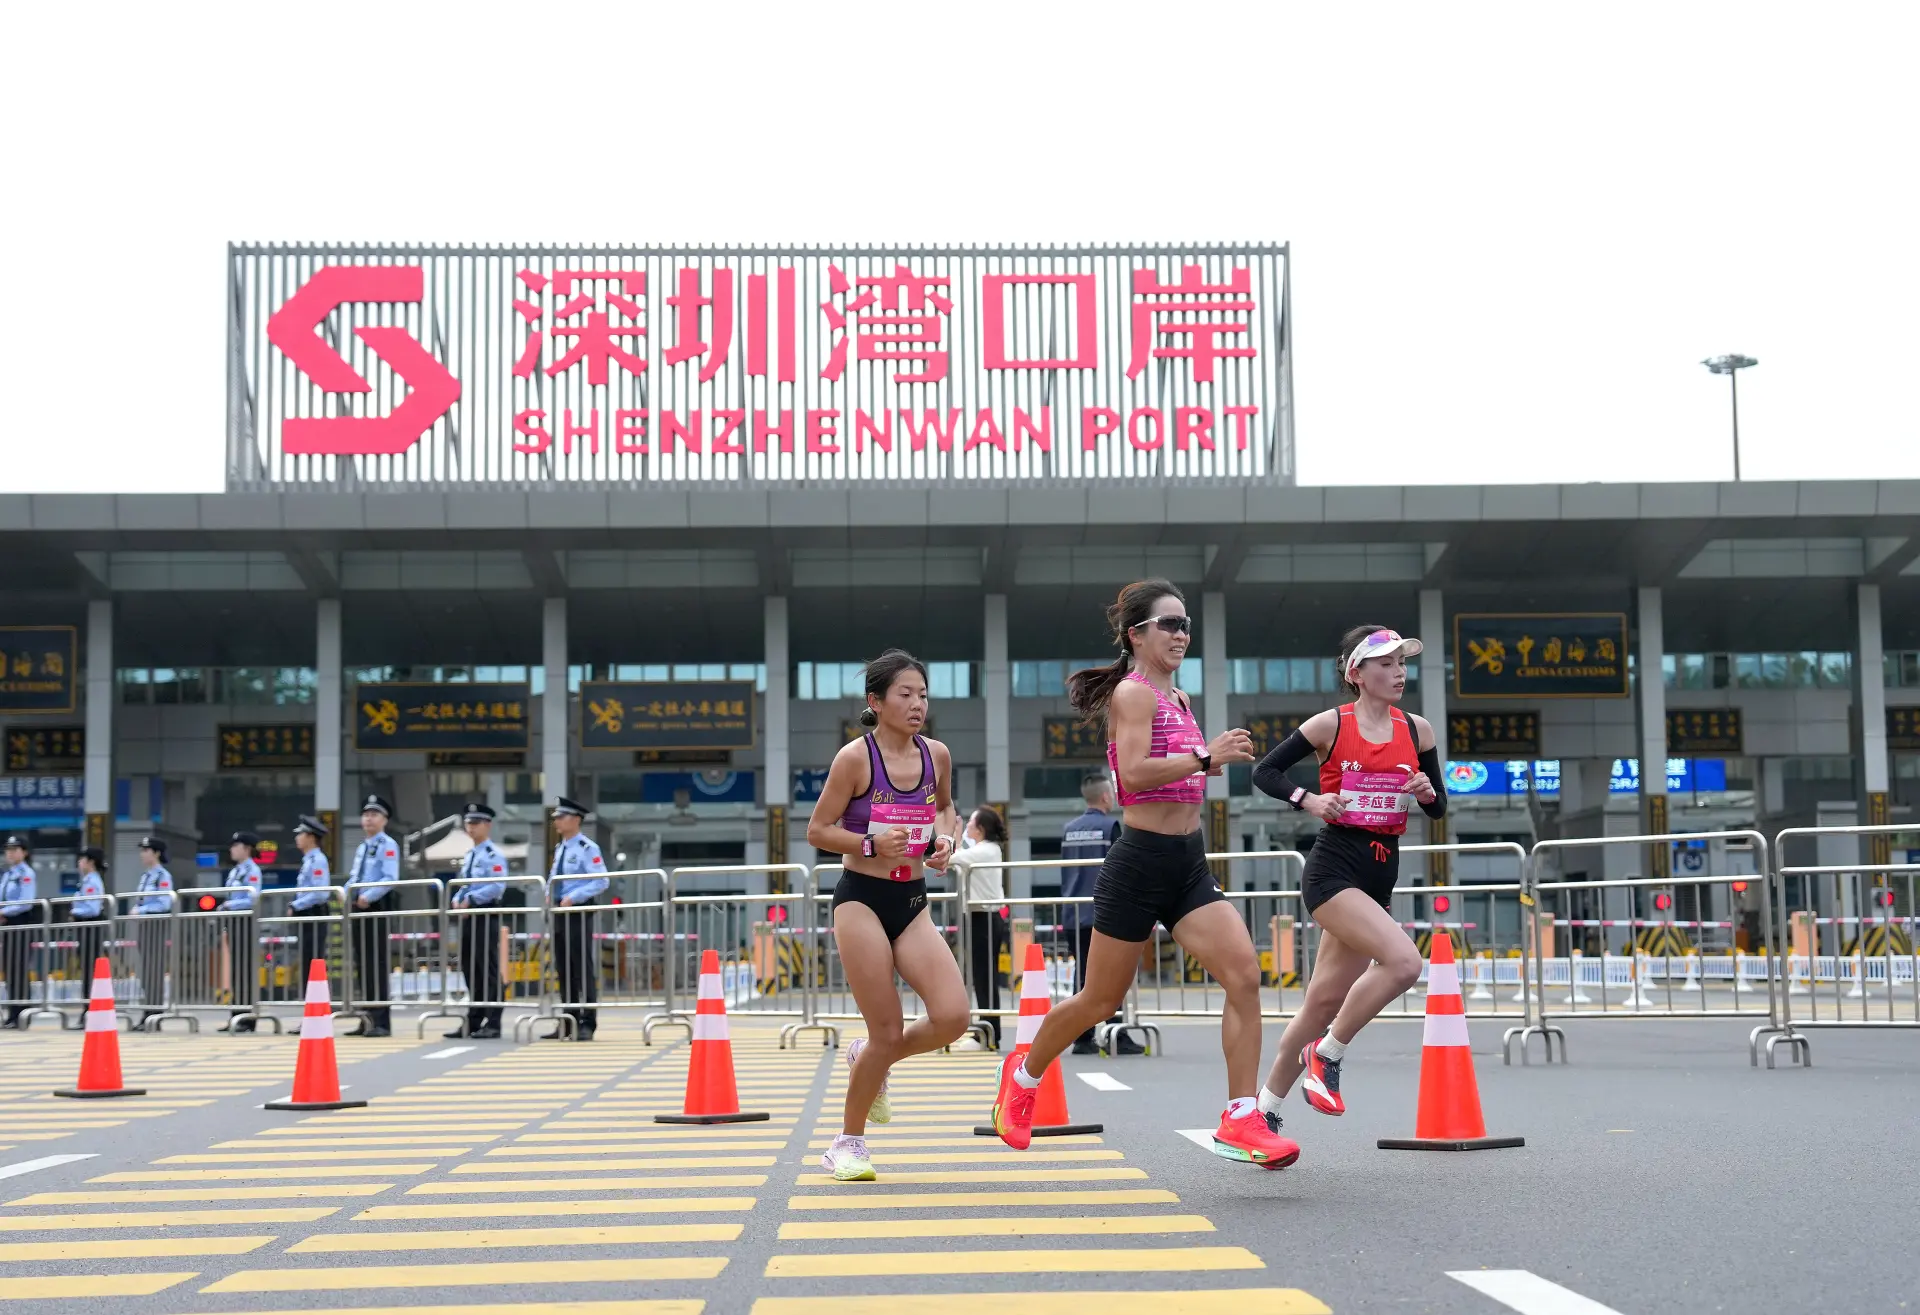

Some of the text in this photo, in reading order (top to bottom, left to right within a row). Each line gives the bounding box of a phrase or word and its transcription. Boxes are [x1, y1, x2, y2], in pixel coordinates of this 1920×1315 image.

[512, 265, 1257, 385] 深圳湾口岸
[513, 405, 1258, 454] SHENZHENWAN PORT
[1357, 794, 1397, 810] 李应美
